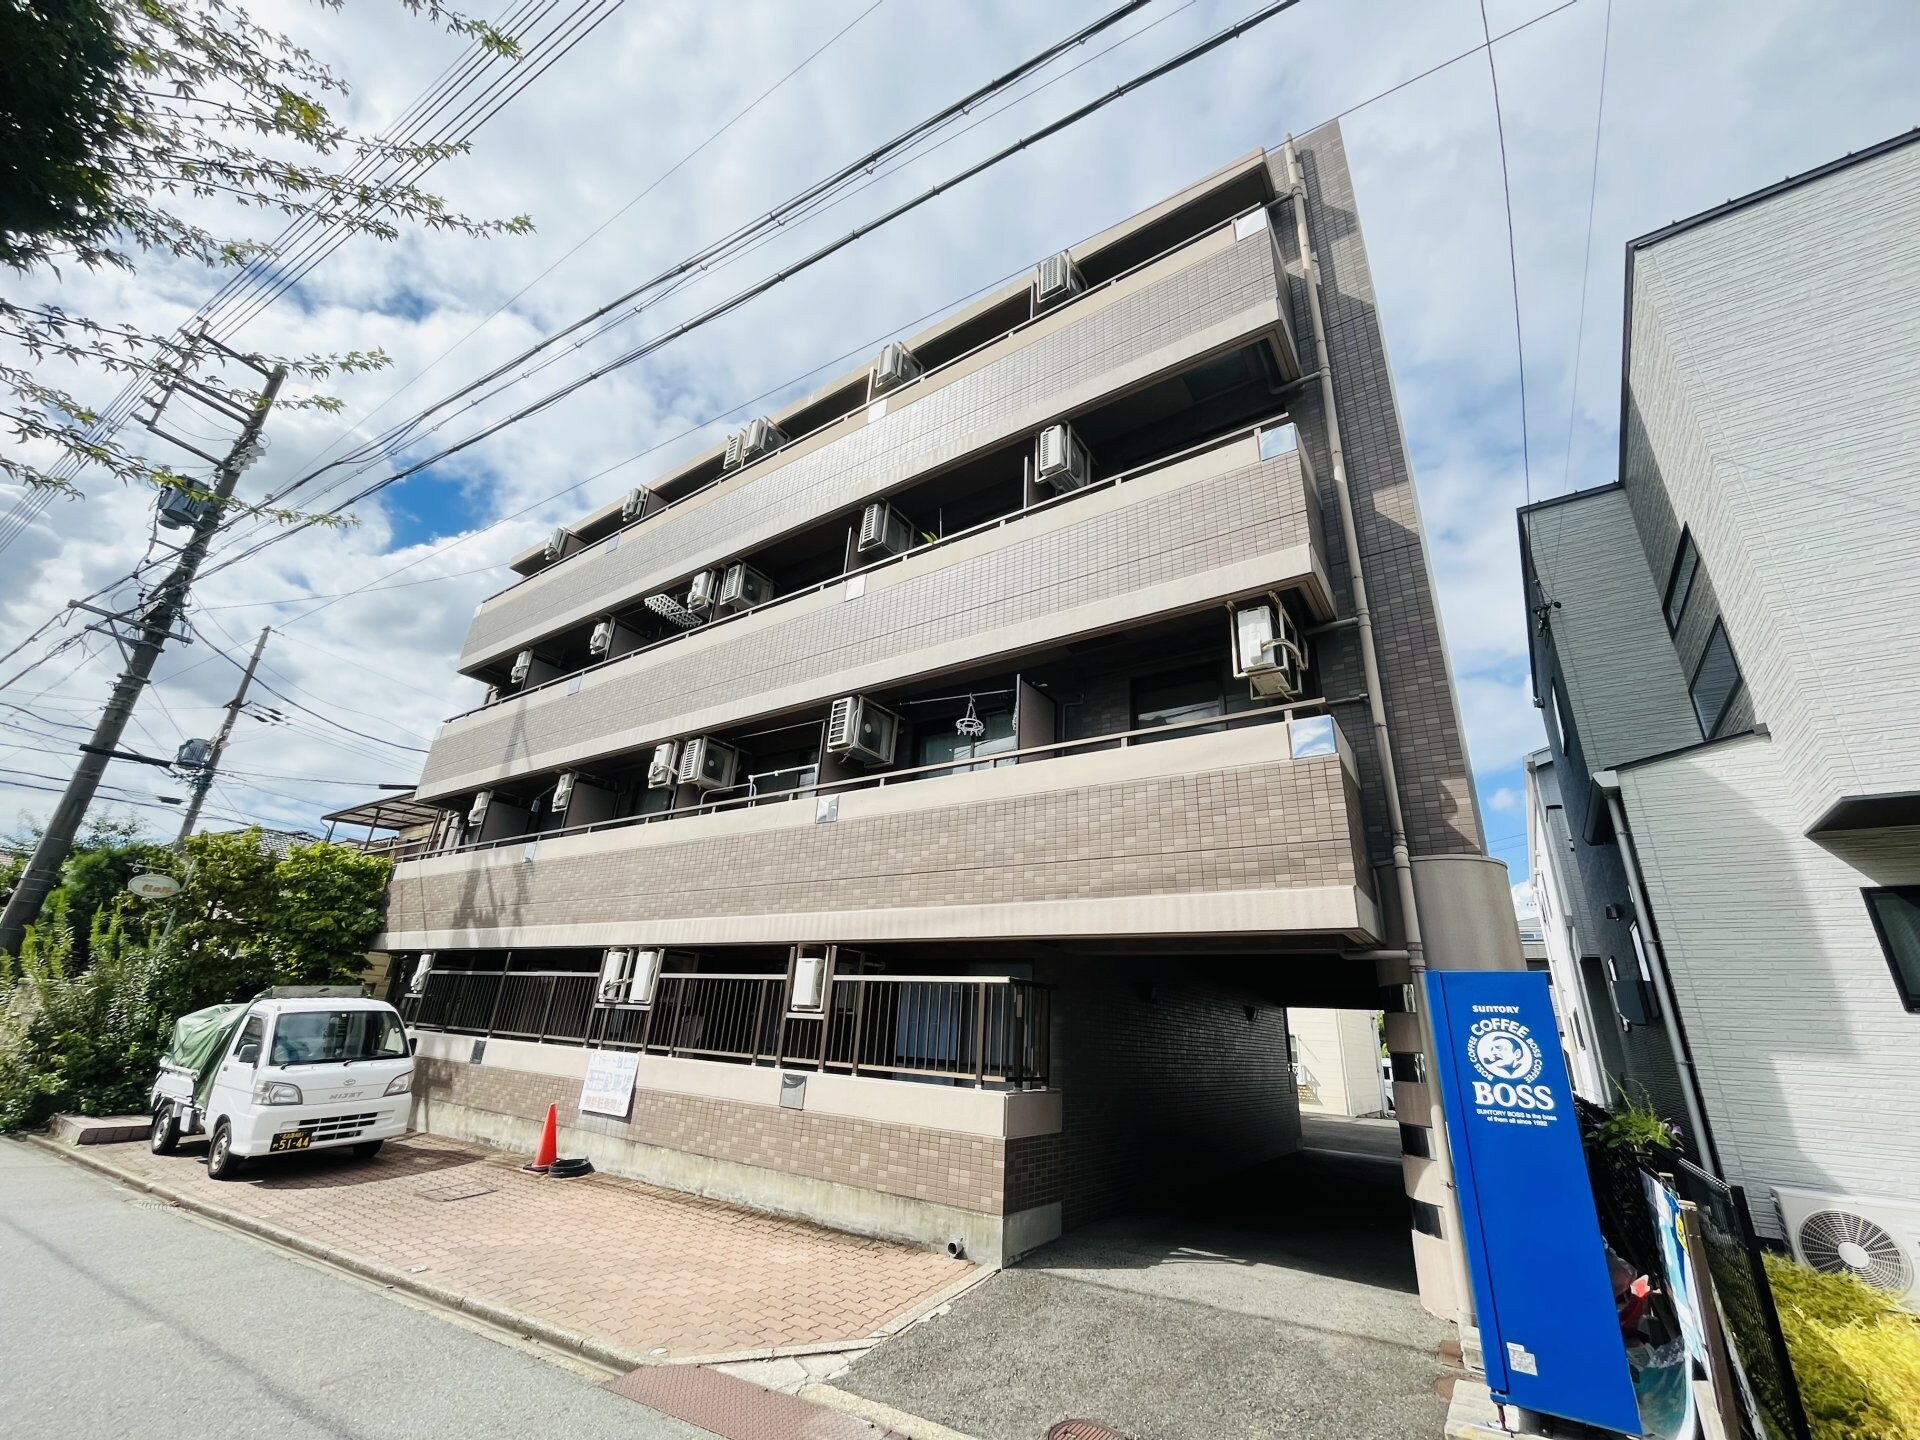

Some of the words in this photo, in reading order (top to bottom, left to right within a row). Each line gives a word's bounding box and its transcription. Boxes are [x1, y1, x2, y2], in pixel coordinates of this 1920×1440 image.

[1472, 1005, 1519, 1014] SUNTORY
[1470, 1017, 1530, 1038] COFFEE
[1467, 1035, 1478, 1063] COFFEE
[1526, 1038, 1542, 1058] BOSS
[1473, 1063, 1494, 1082] BOSS
[1523, 1059, 1543, 1084] COFFEE
[1472, 1081, 1555, 1110] BOSS
[1506, 1110, 1526, 1118] BOSS
[1542, 1113, 1558, 1121] boss
[1516, 1118, 1532, 1126] since
